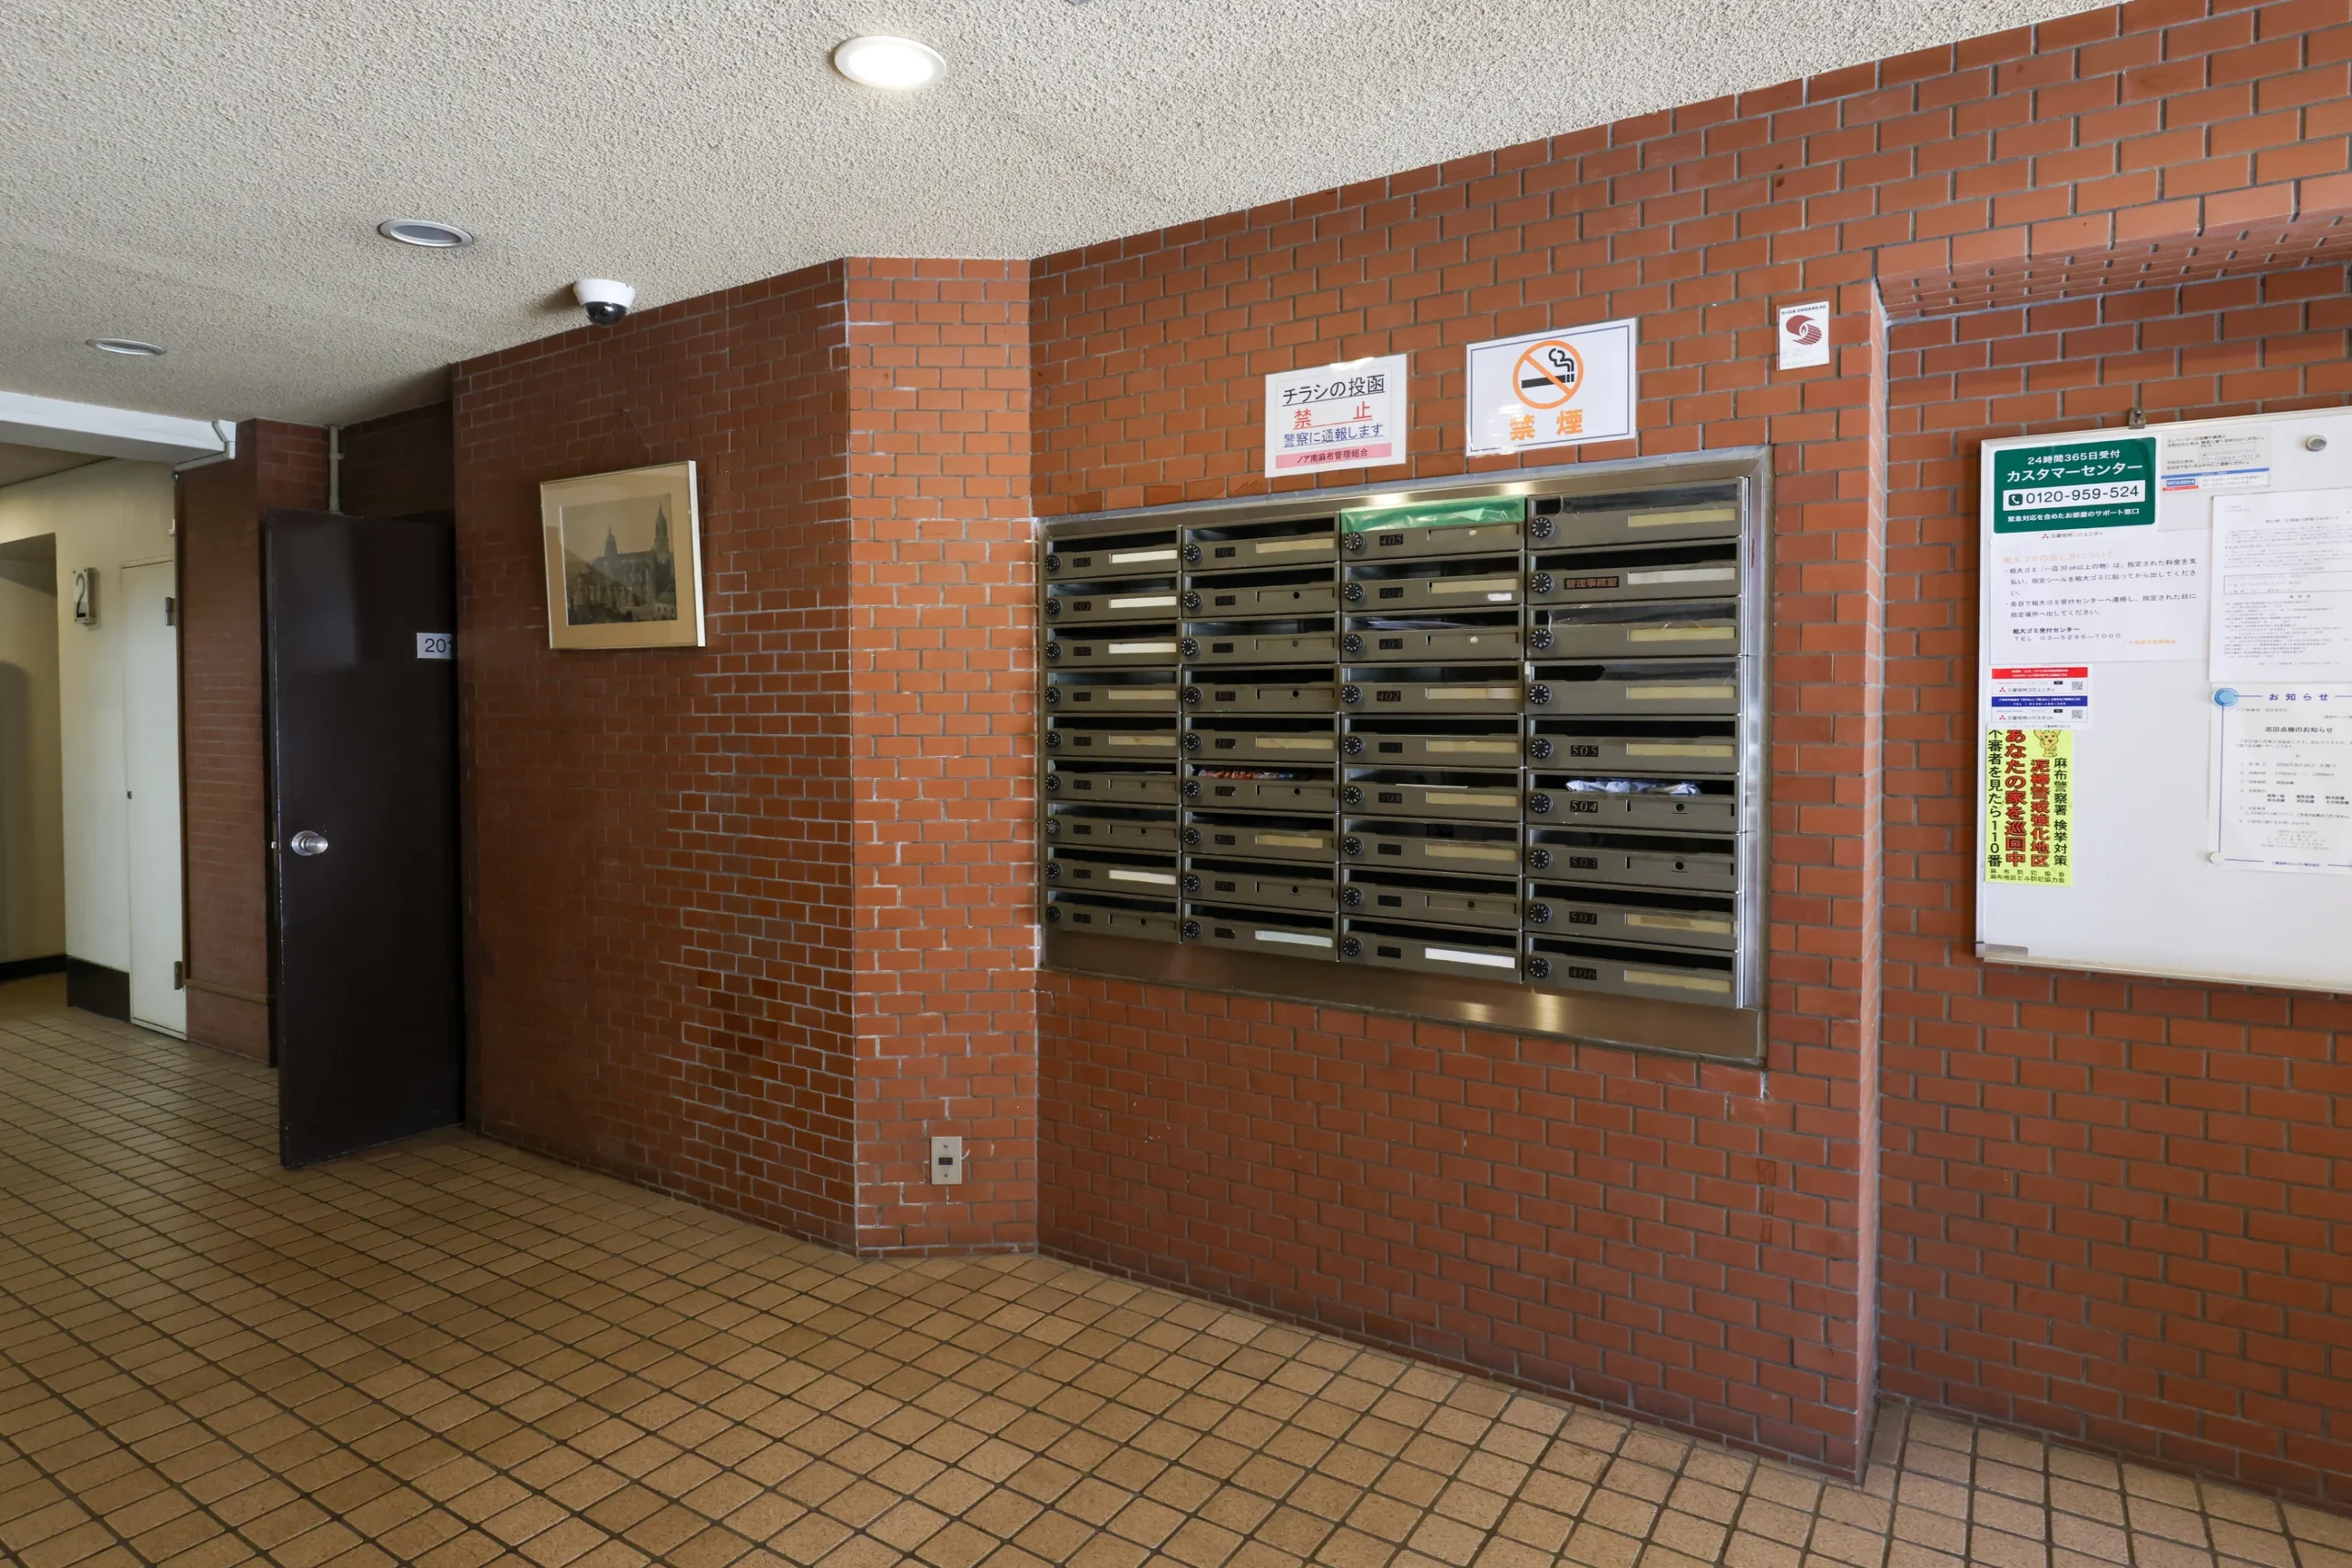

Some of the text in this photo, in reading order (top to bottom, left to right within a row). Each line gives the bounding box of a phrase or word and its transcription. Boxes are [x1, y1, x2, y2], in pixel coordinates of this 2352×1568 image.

[1283, 374, 1385, 404] チラシの投函
[1510, 409, 1584, 441] 禁煙
[1283, 423, 1384, 447] 警察に通報します
[1296, 448, 1368, 464] ノア南麻布管理組合
[2028, 449, 2120, 465] 24時間365日受付
[2007, 462, 2143, 482] カスタマーセンター
[2026, 485, 2139, 503] 0120-959-524
[2007, 508, 2140, 522] 緊急対応を含めたお部屋のサポート窓口
[1381, 535, 1402, 545] 405
[2004, 551, 2113, 563] 粗大ゴミの出し方について
[1566, 577, 1617, 589] 管理事務室
[76, 573, 85, 617] 2
[1378, 692, 1400, 701] 402
[2268, 693, 2329, 701] お知らせ
[1571, 745, 1598, 756] 505
[2005, 729, 2027, 867] あなたの家を巡回中
[1570, 801, 1598, 812] 504
[2030, 759, 2050, 867] 泥棒警戒強化地区
[2053, 758, 2067, 865] 麻布警察署 検挙対策
[1572, 857, 1596, 868] 503
[1571, 912, 1595, 924] 501
[1570, 967, 1596, 979] 406
